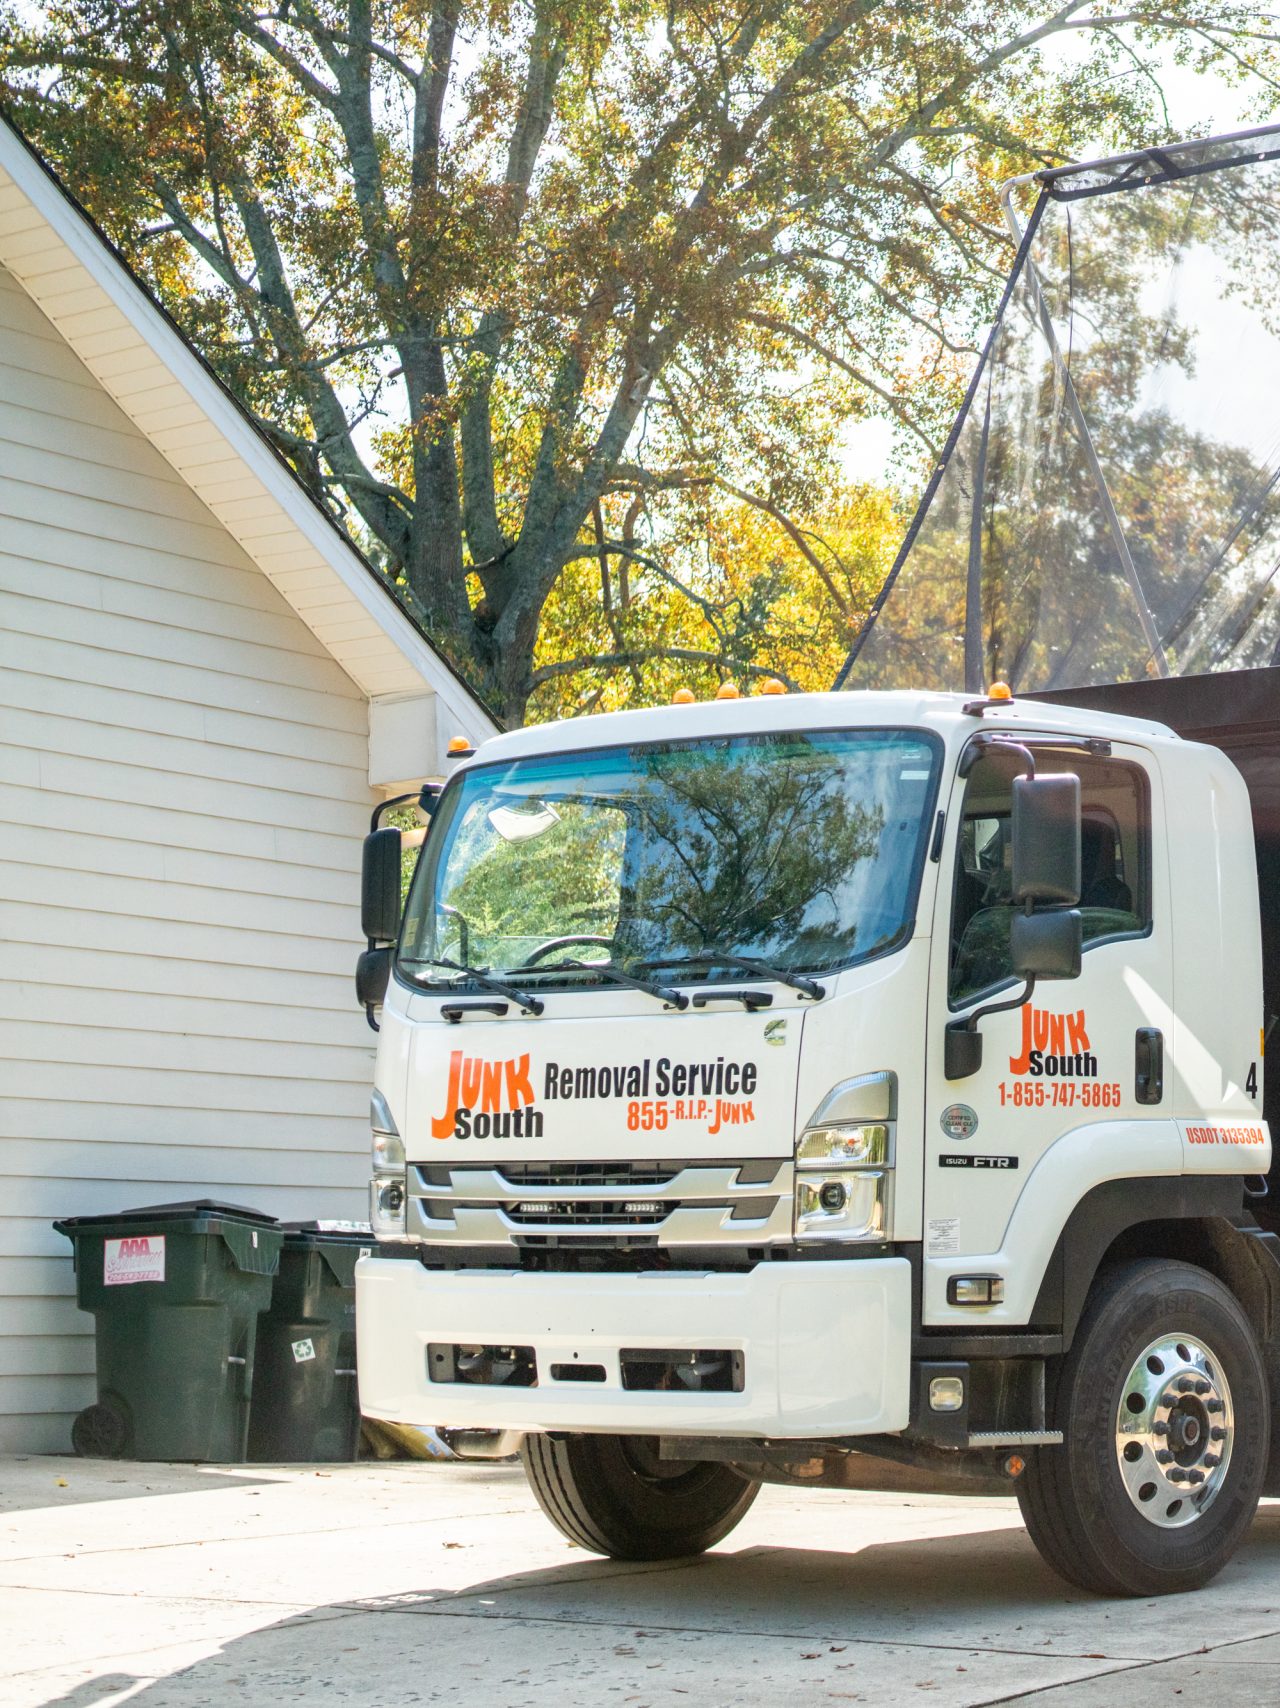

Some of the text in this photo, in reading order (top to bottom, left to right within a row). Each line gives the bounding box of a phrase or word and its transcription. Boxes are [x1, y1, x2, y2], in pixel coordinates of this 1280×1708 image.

[1009, 1002, 1091, 1076] JUNK
[544, 1056, 757, 1100] Removal Service
[1029, 1050, 1098, 1077] South
[431, 1050, 535, 1140] JUNK
[998, 1081, 1121, 1108] 1-855-747-5865
[1245, 1062, 1258, 1099] 4
[454, 1106, 544, 1140] South
[1185, 1127, 1265, 1145] USDOT 3135394
[973, 1157, 1010, 1168] FTR
[118, 1238, 151, 1258] AAA
